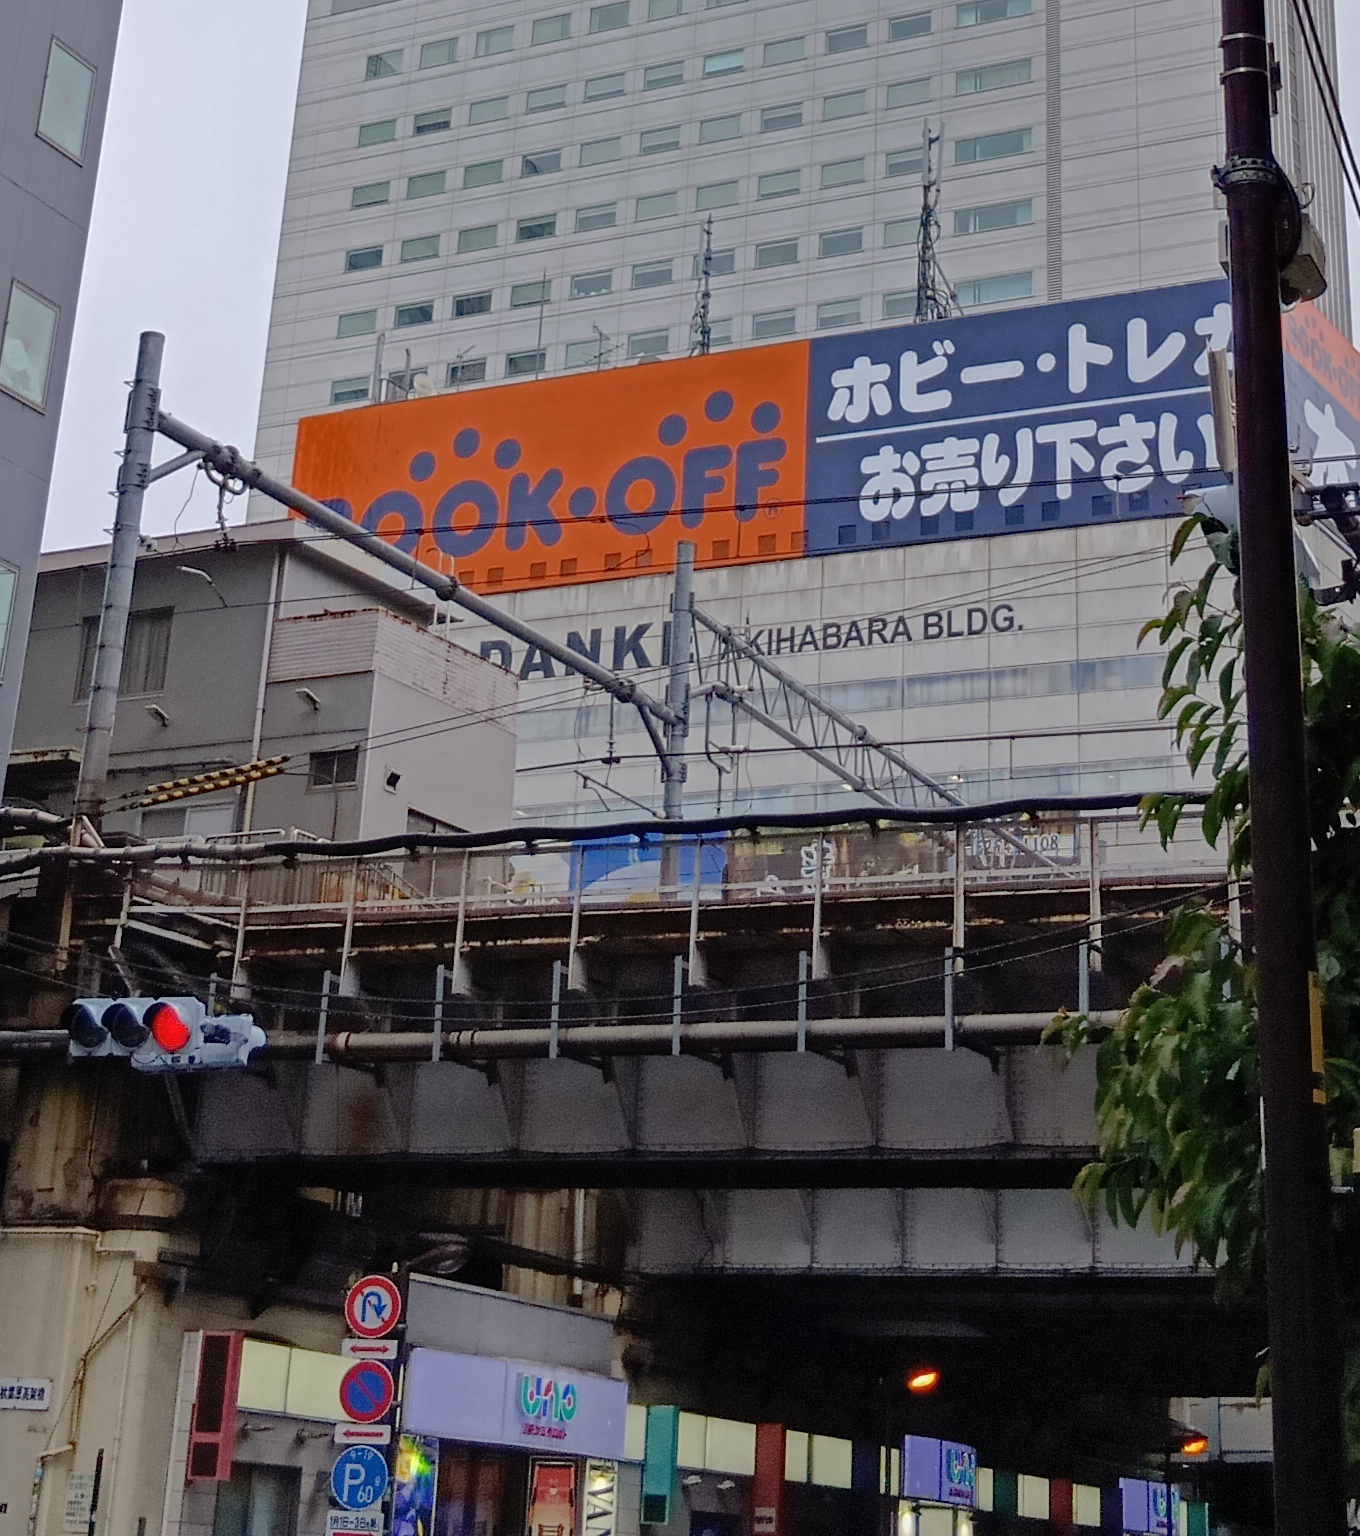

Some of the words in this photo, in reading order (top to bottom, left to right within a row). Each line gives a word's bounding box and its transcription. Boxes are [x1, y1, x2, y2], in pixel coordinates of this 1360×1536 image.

[923, 603, 1024, 639] BLDG.
[342, 1463, 366, 1502] P
[357, 1485, 374, 1503] 60
